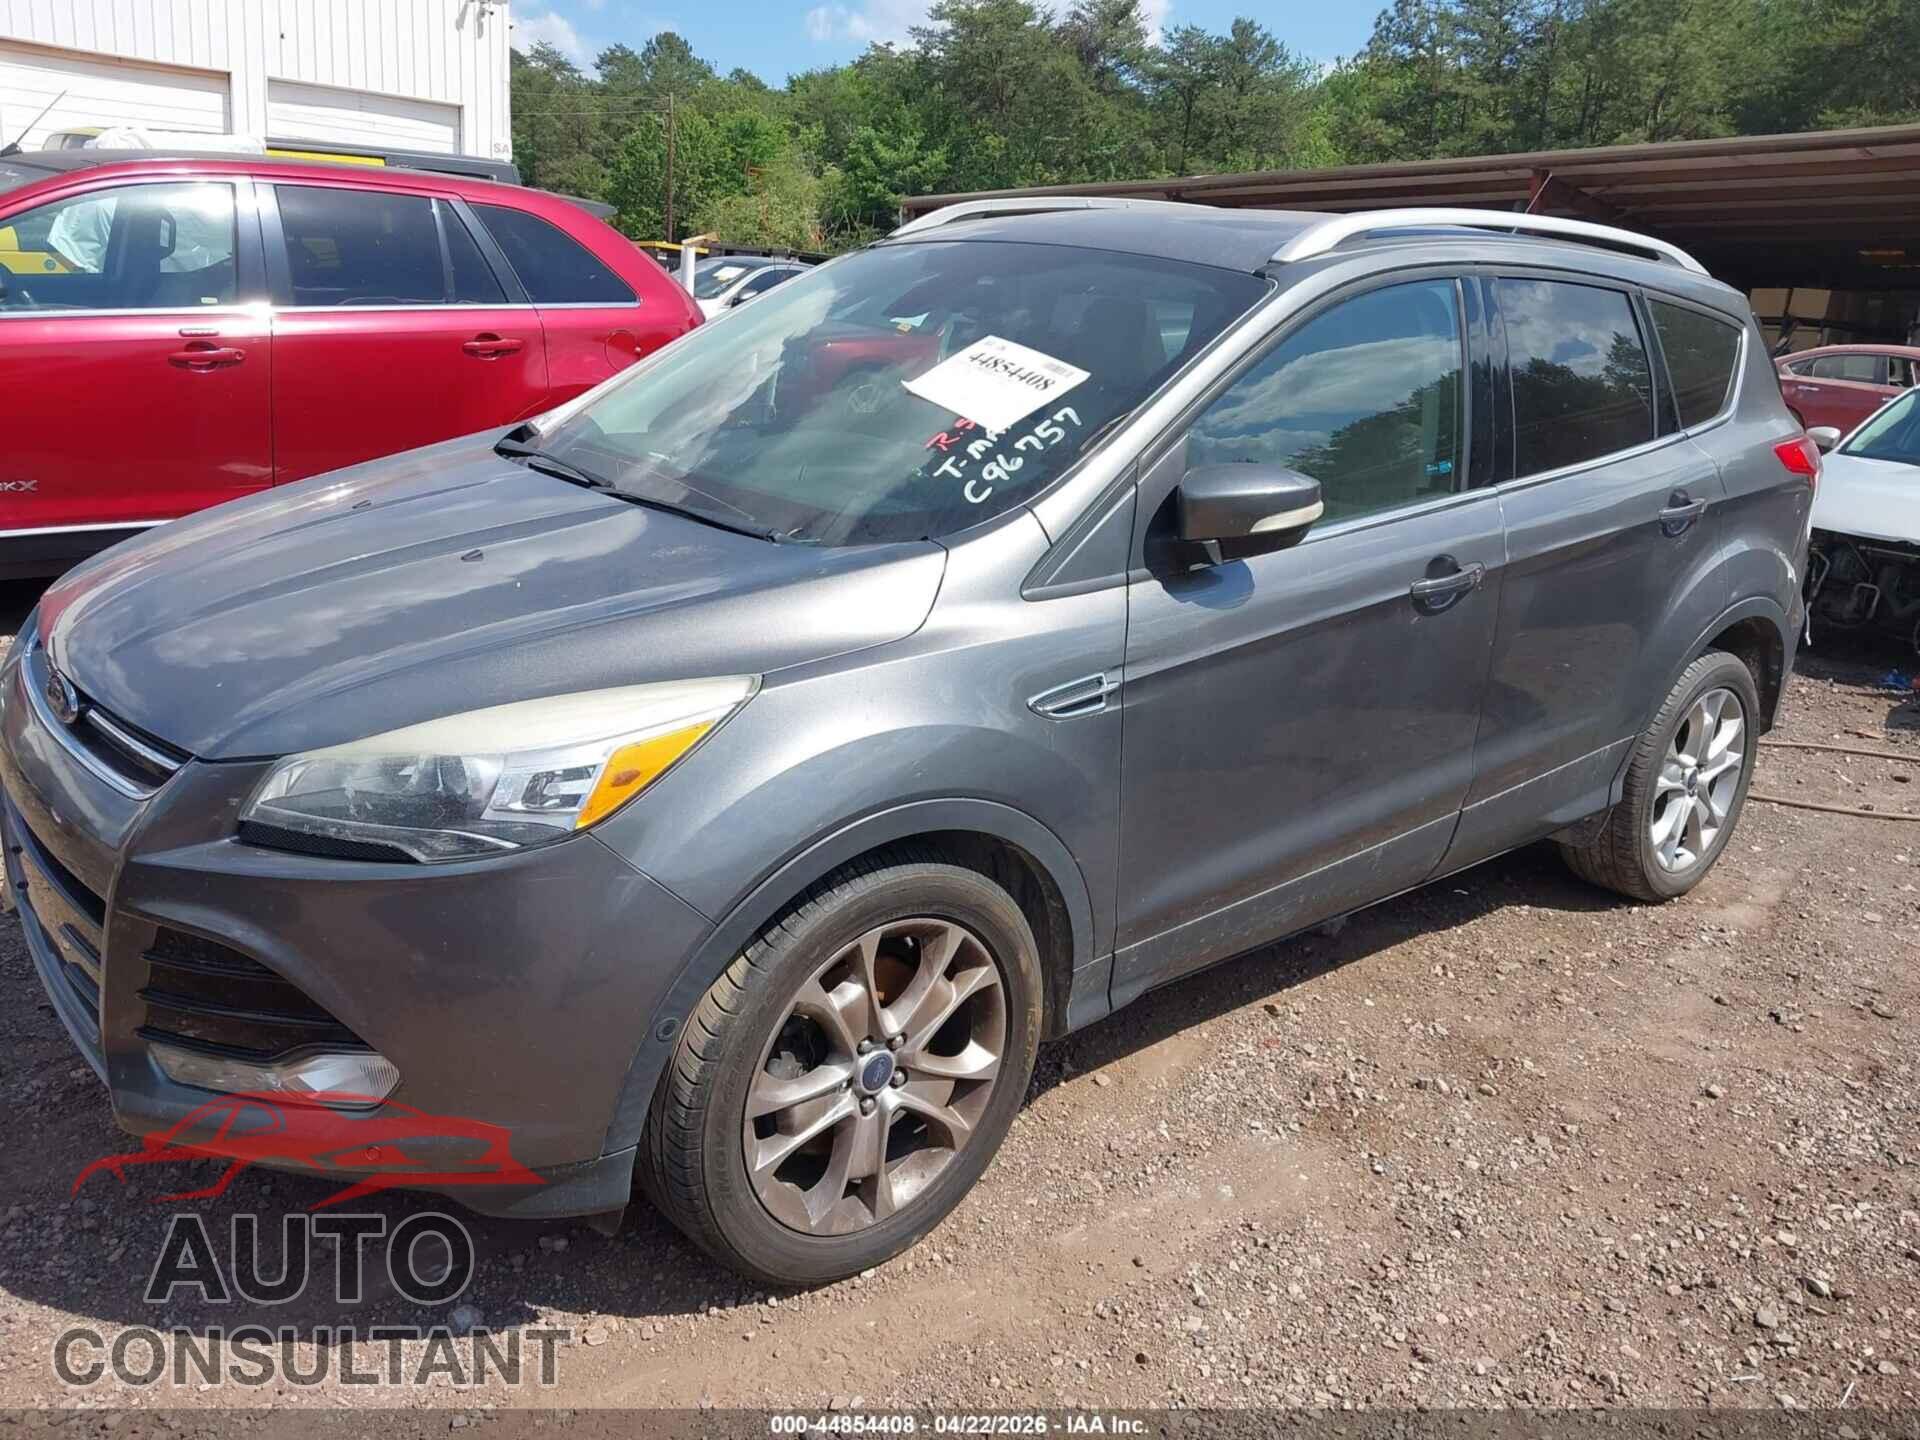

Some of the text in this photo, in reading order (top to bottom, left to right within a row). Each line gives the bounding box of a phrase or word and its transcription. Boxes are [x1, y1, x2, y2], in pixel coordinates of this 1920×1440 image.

[969, 352, 1056, 391] 44854408
[963, 406, 1083, 504] C96757
[0, 479, 38, 492] KX
